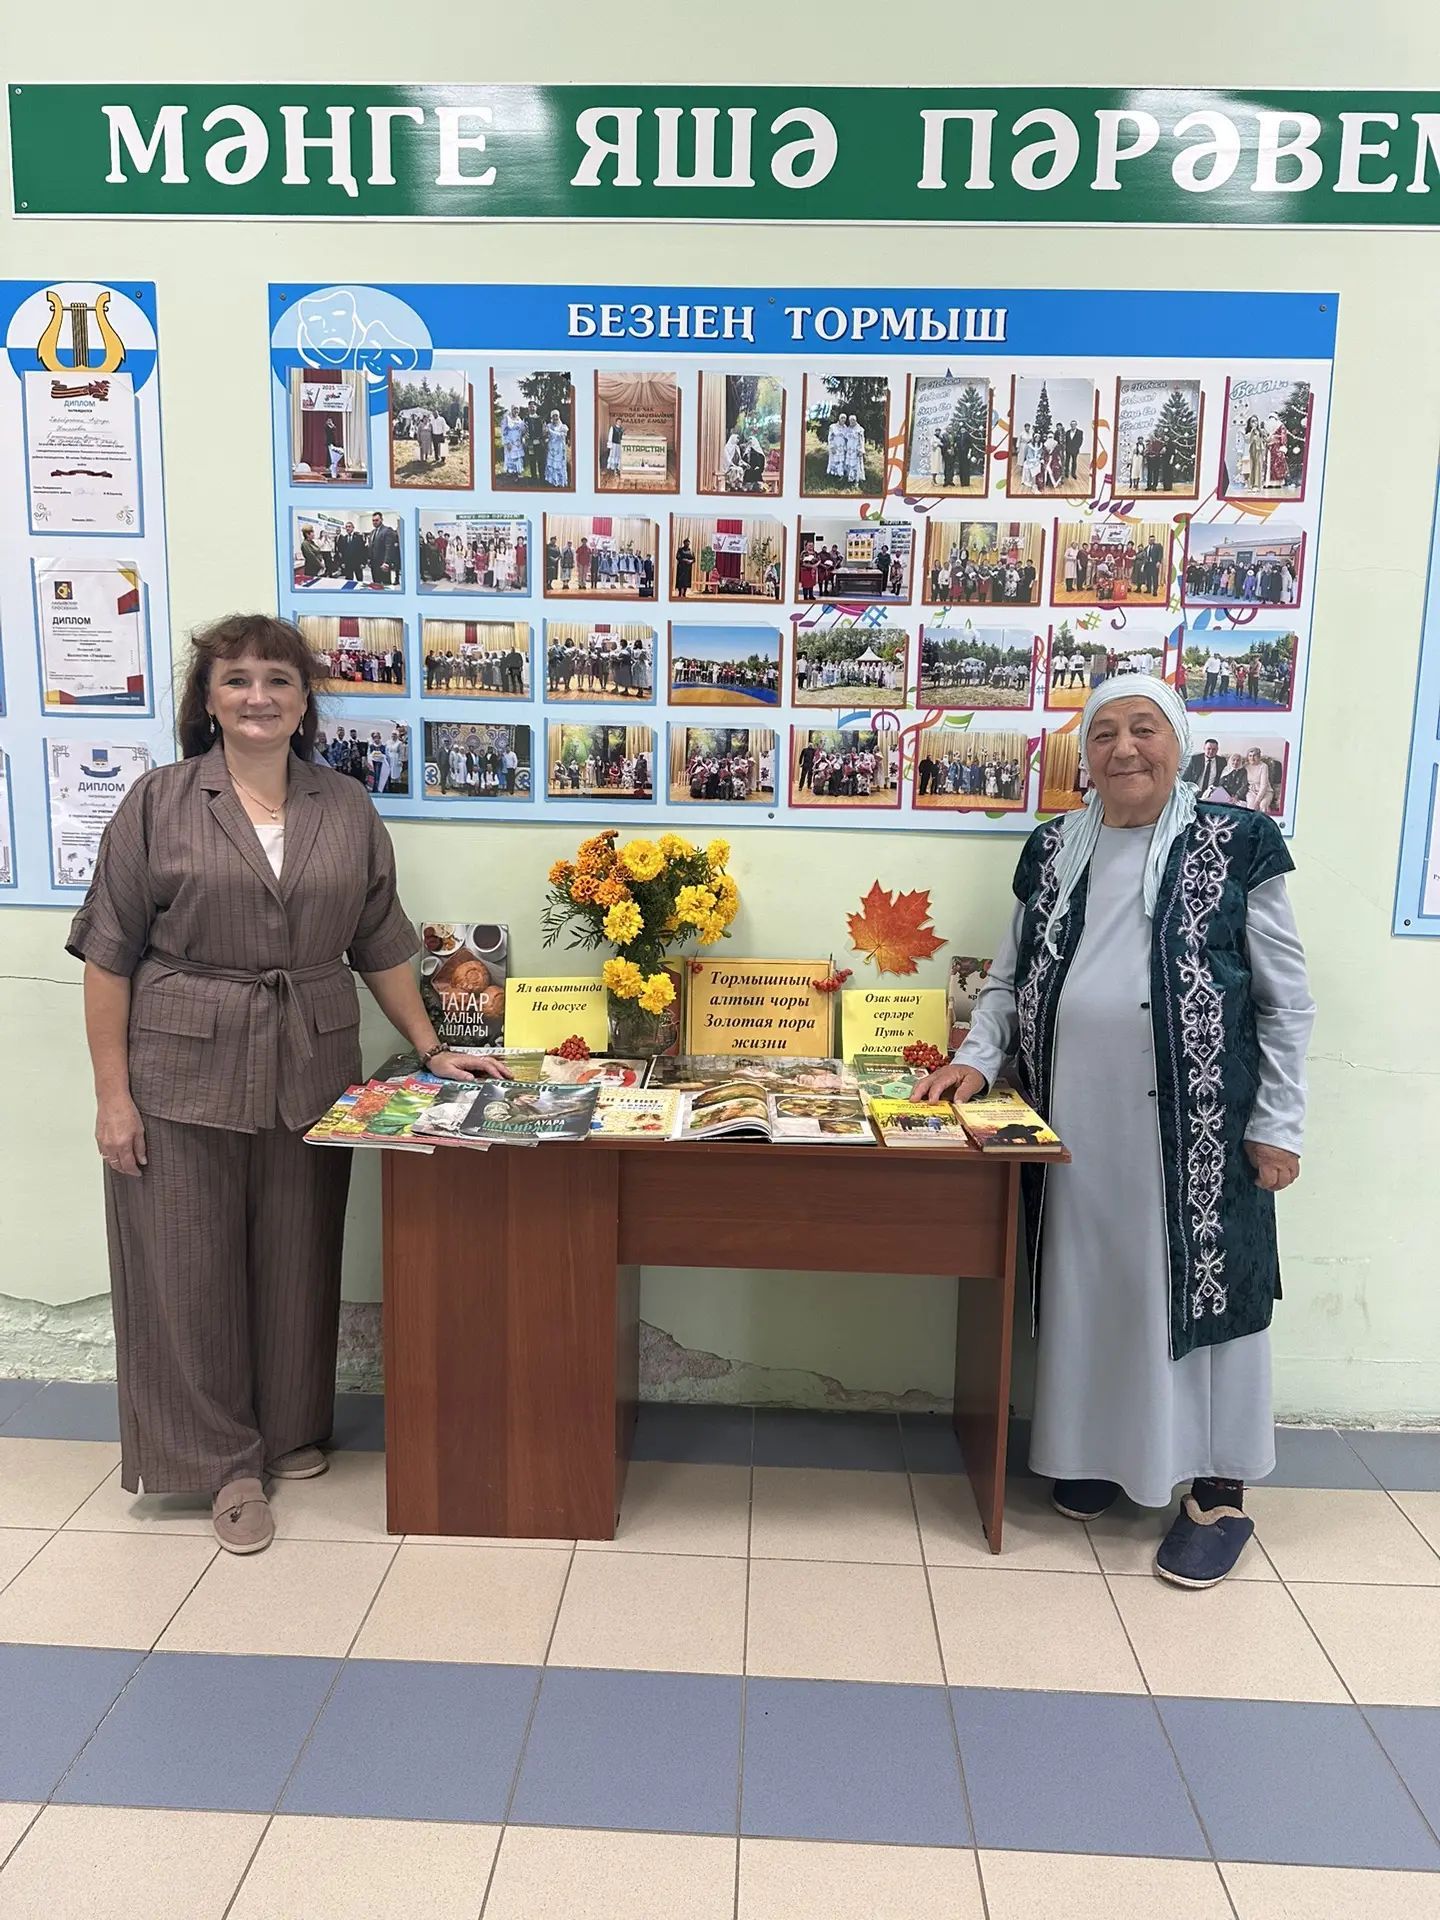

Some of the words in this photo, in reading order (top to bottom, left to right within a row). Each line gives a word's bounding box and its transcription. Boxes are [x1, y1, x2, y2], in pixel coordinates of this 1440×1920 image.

[101, 104, 497, 198] МӘҢГЕ
[569, 106, 839, 190] ЯШӘ
[567, 303, 756, 343] БЕЗНЕҢ
[784, 307, 1009, 342] ТОРМЫШ
[64, 399, 96, 407] ДИПЛОМ
[622, 444, 665, 453] ТАТАРСТАН
[52, 616, 91, 625] ДИПЛОМ
[78, 781, 125, 792] ДИПЛОМ
[710, 971, 811, 988] Тормышның
[516, 983, 532, 993] Ял
[535, 982, 602, 993] вакытында
[439, 991, 490, 1011] ТАТАР
[709, 996, 765, 1006] алтын
[770, 997, 810, 1010] чоры
[864, 993, 891, 1003] Озак
[893, 995, 922, 1005] яшәү
[531, 1001, 549, 1011] На
[551, 1000, 588, 1013] досуге
[443, 1012, 484, 1025] ХАЛЫК
[873, 1010, 914, 1021] серләре
[703, 1013, 773, 1028] Золотая
[777, 1018, 816, 1031] пора
[437, 1024, 489, 1037] АШЛАРЫ
[874, 1027, 905, 1038] Путь
[731, 1037, 787, 1049] жизни
[861, 1043, 904, 1053] долголе
